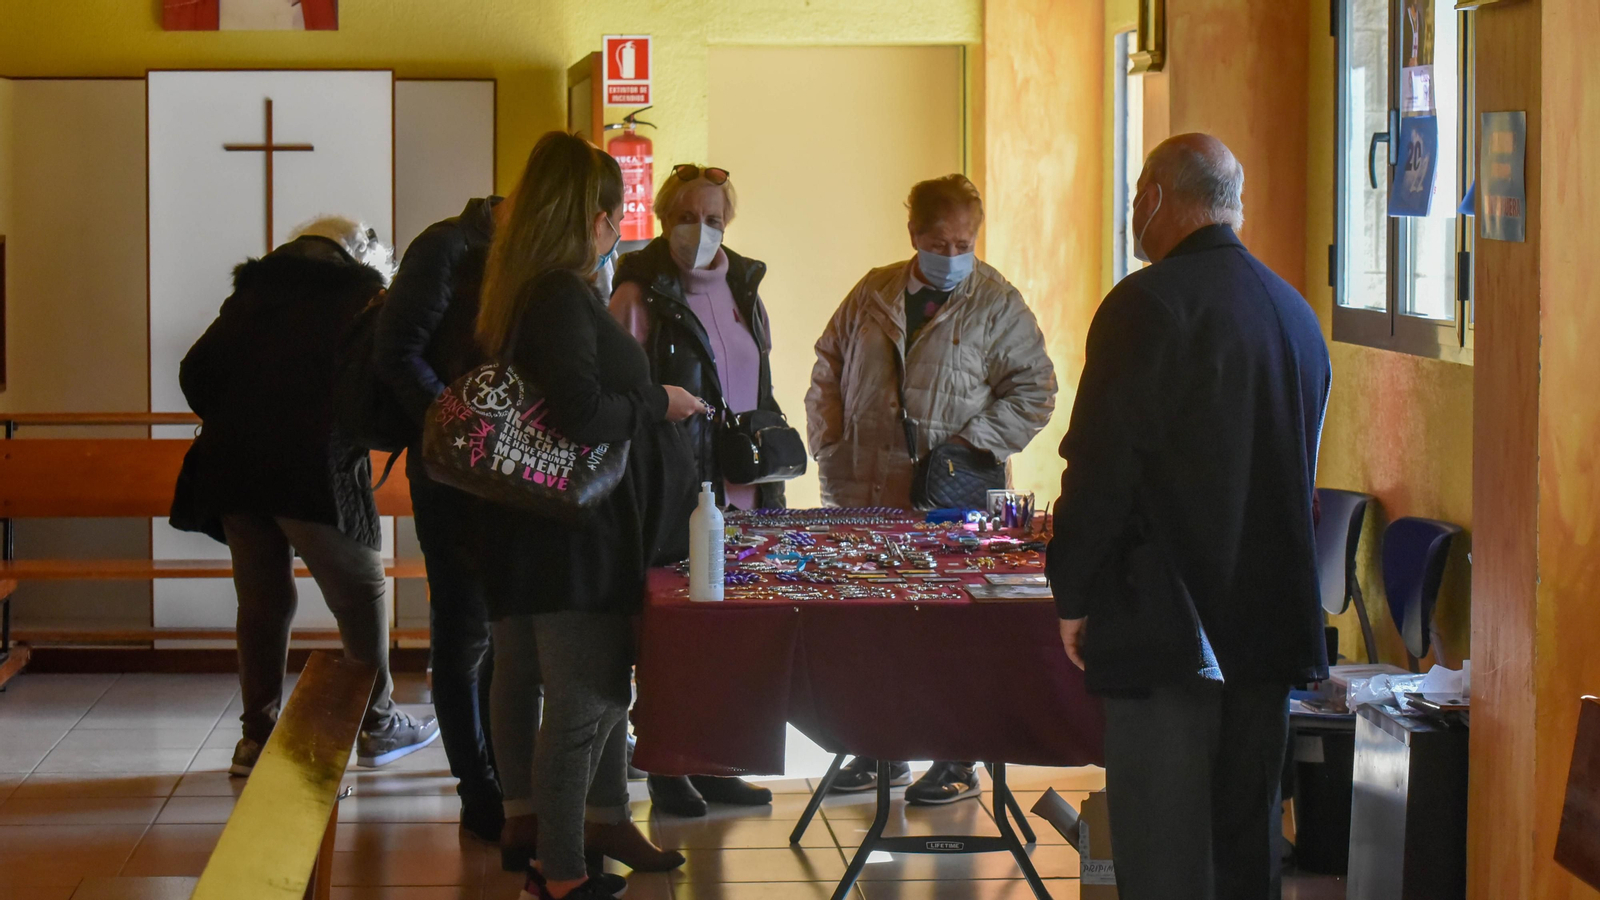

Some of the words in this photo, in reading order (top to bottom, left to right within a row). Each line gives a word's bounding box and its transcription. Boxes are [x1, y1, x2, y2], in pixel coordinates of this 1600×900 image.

[609, 86, 638, 94] EXTINTOR
[639, 86, 648, 94] DE
[611, 94, 645, 102] INCENDIOS
[436, 387, 473, 421] SINCE
[468, 418, 496, 467] DIVA
[499, 432, 512, 445] WE
[512, 439, 536, 455] HAVE
[536, 450, 567, 466] FOUND
[502, 422, 530, 444] THIS
[490, 454, 516, 475] TO
[522, 466, 569, 491] LOVE
[494, 441, 573, 478] MOMENT
